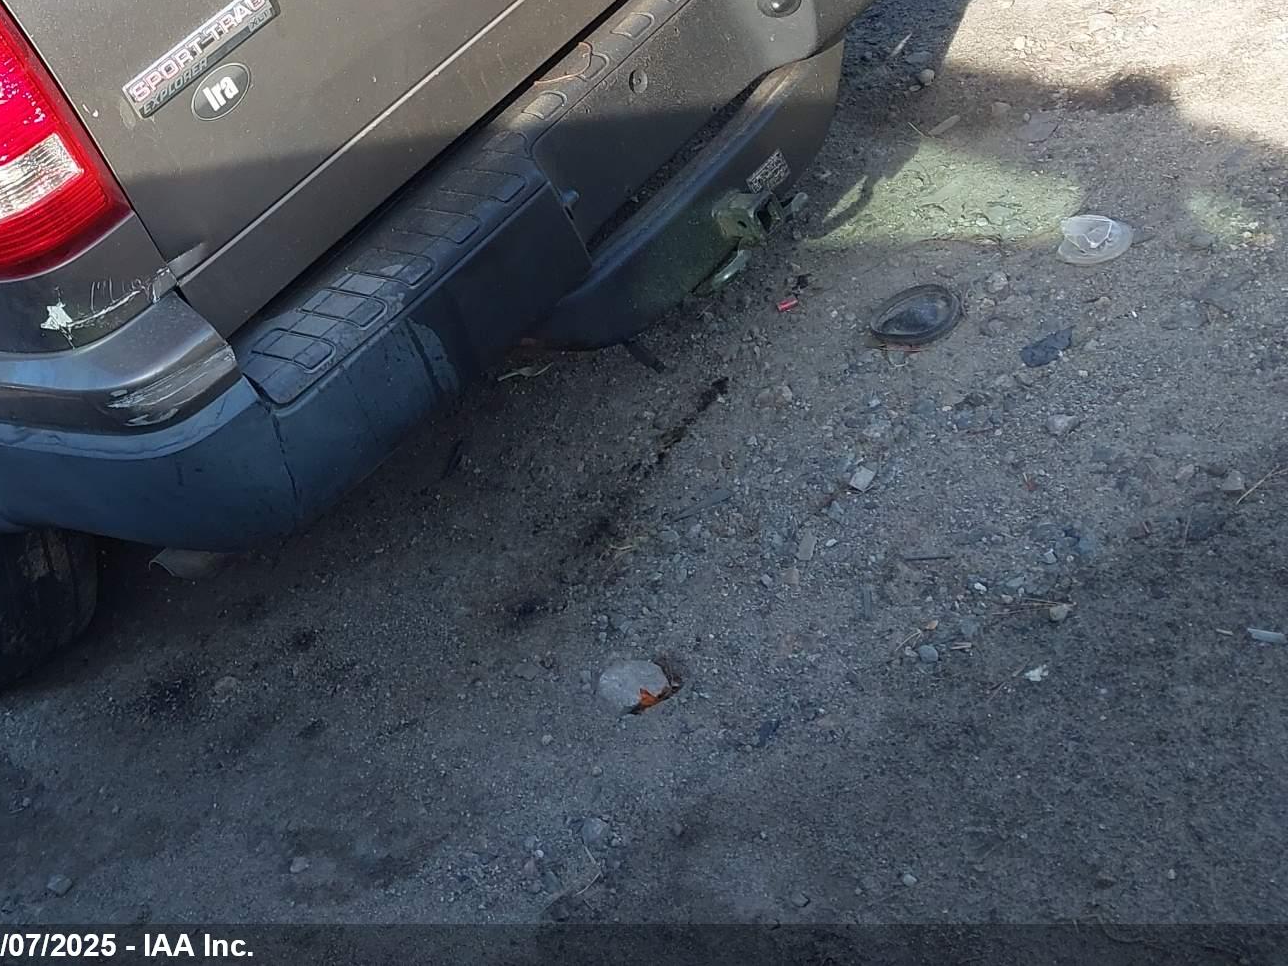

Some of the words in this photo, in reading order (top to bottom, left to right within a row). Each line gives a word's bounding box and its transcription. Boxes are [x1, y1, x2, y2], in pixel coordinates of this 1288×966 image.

[143, 56, 208, 114] EXPLORER
[249, 7, 275, 29] XLT
[202, 76, 239, 111] Ira
